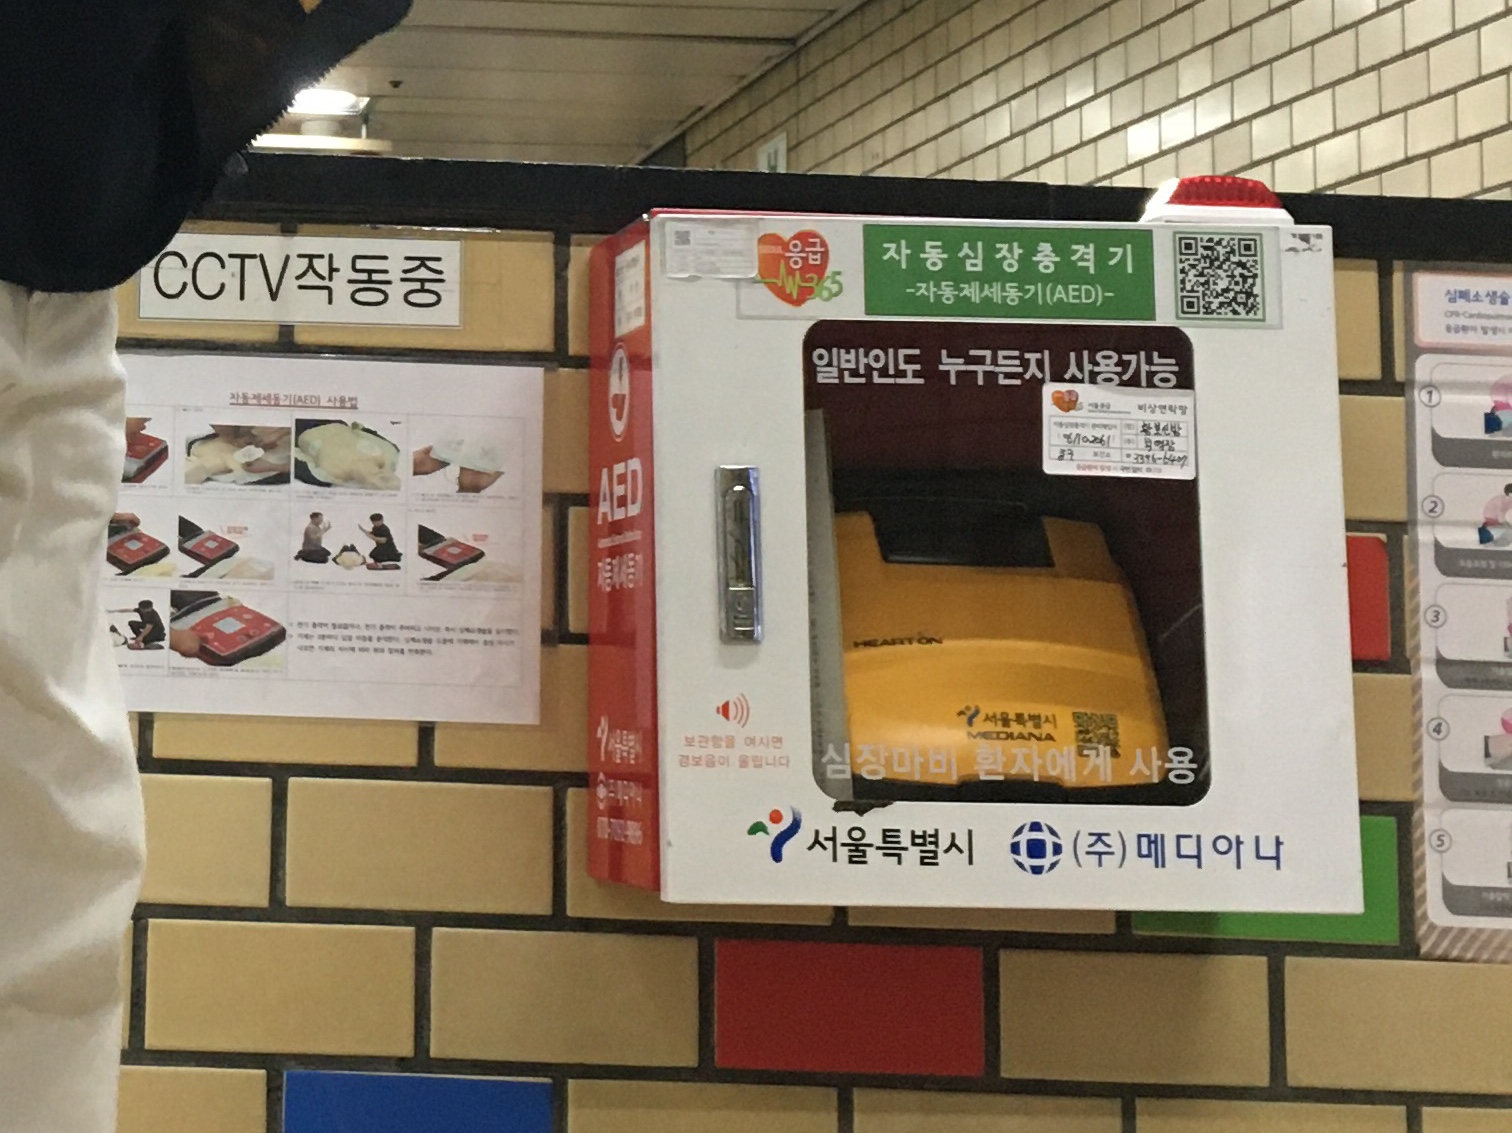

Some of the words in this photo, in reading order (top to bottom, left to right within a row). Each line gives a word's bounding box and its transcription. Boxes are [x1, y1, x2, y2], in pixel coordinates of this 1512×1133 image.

[784, 237, 825, 270] 응급
[153, 250, 447, 308] CCTV작동중
[804, 270, 843, 302] 365
[812, 347, 925, 384] 일반인도
[938, 349, 1051, 386] 누구든지
[1063, 350, 1180, 388] 사용가능
[326, 395, 358, 409] 사용법
[597, 457, 643, 525] AED
[983, 711, 1057, 729] 서울특별시
[683, 735, 735, 749] 보관함을
[744, 736, 783, 750] 여시면
[967, 730, 1056, 743] MEDIANA
[678, 754, 730, 768] 경보음이
[738, 754, 790, 769] 울립니다
[821, 742, 958, 781] 심장마비
[974, 743, 1112, 783] 환자에게
[1129, 745, 1198, 785] 사용
[807, 826, 975, 866] 서울특별시
